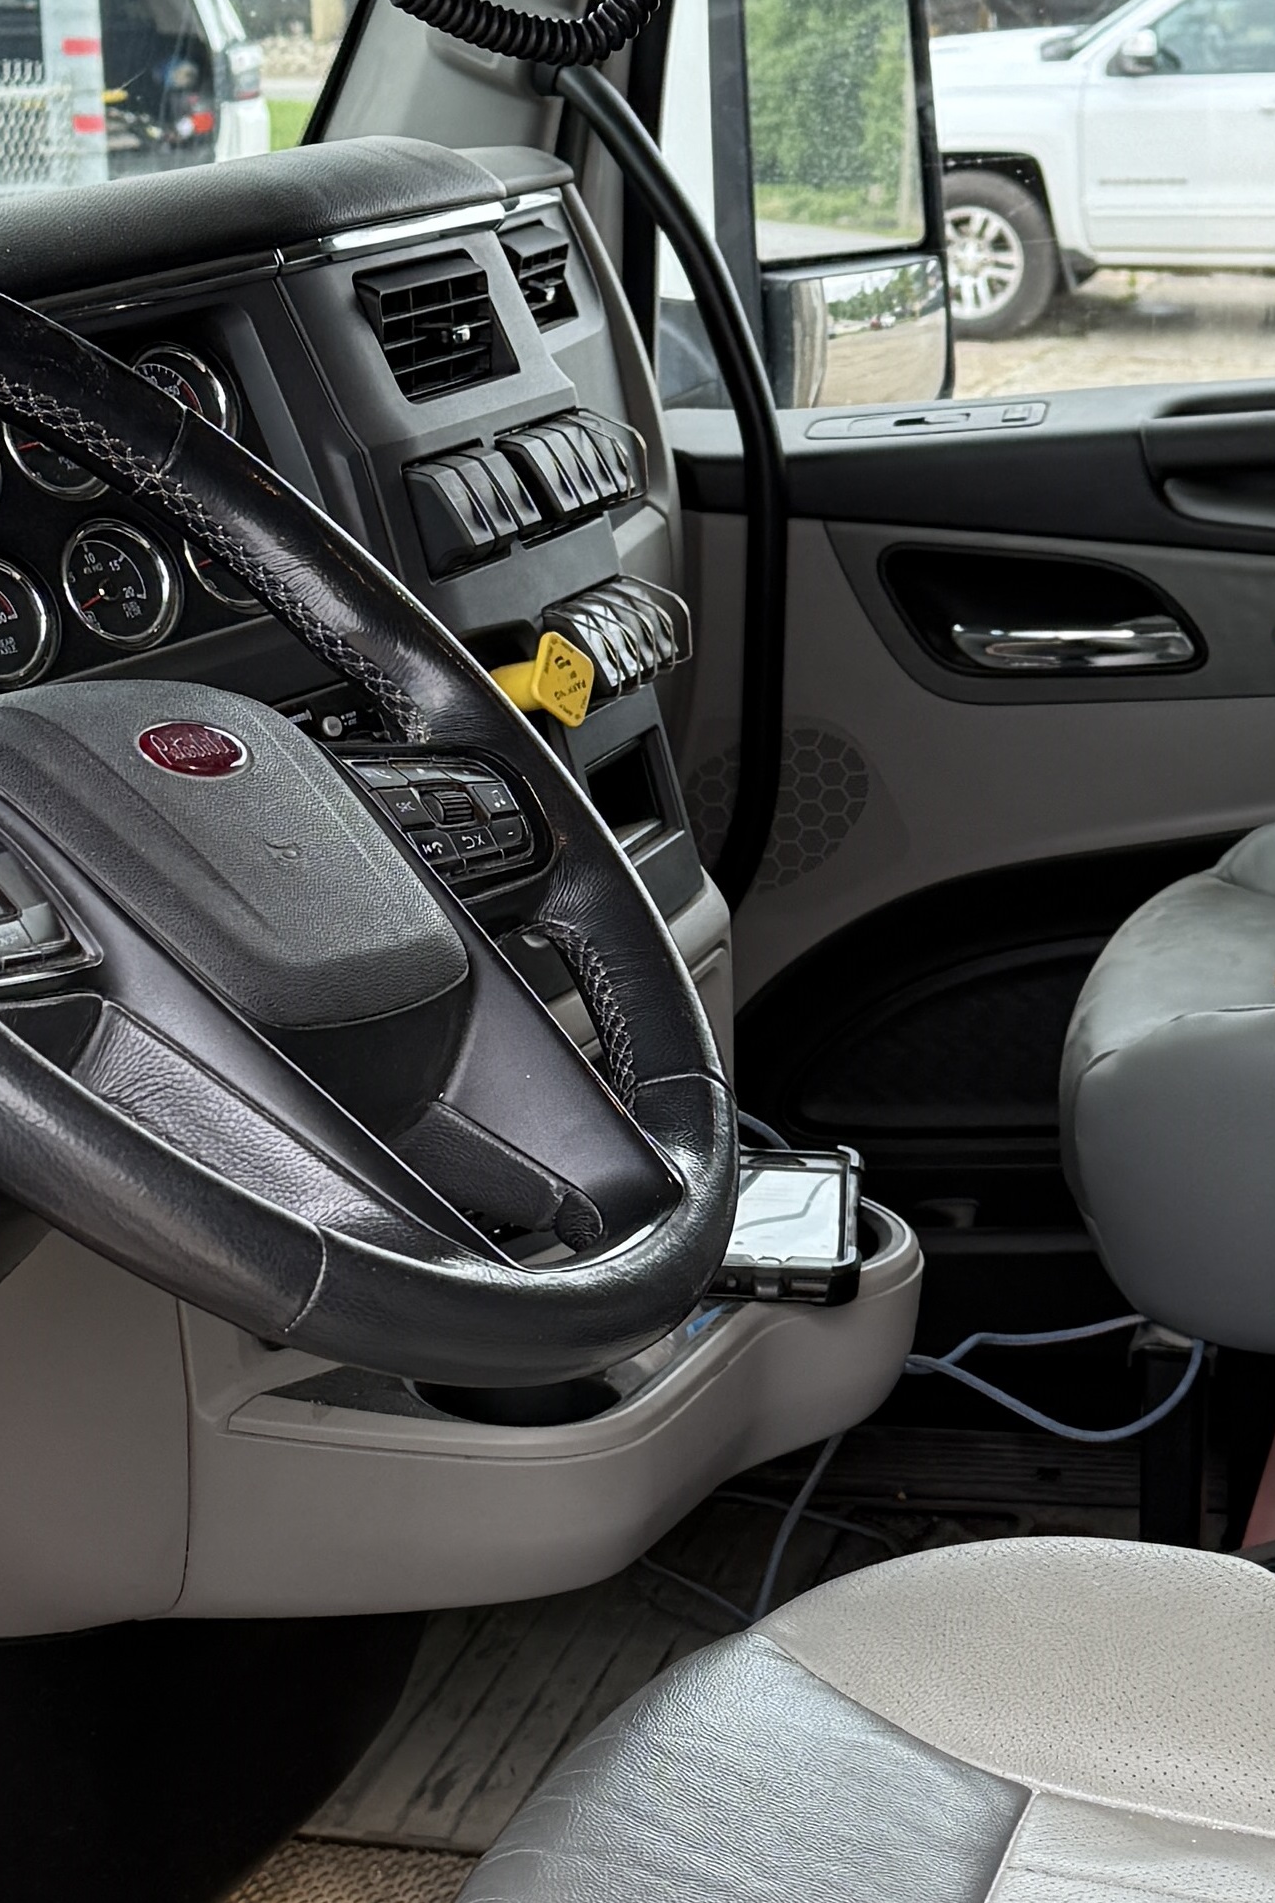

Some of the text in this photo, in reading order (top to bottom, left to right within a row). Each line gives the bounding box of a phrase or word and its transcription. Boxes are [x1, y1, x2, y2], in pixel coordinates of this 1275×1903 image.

[84, 552, 96, 565] 10
[109, 560, 120, 571] 15
[123, 586, 135, 598] 20
